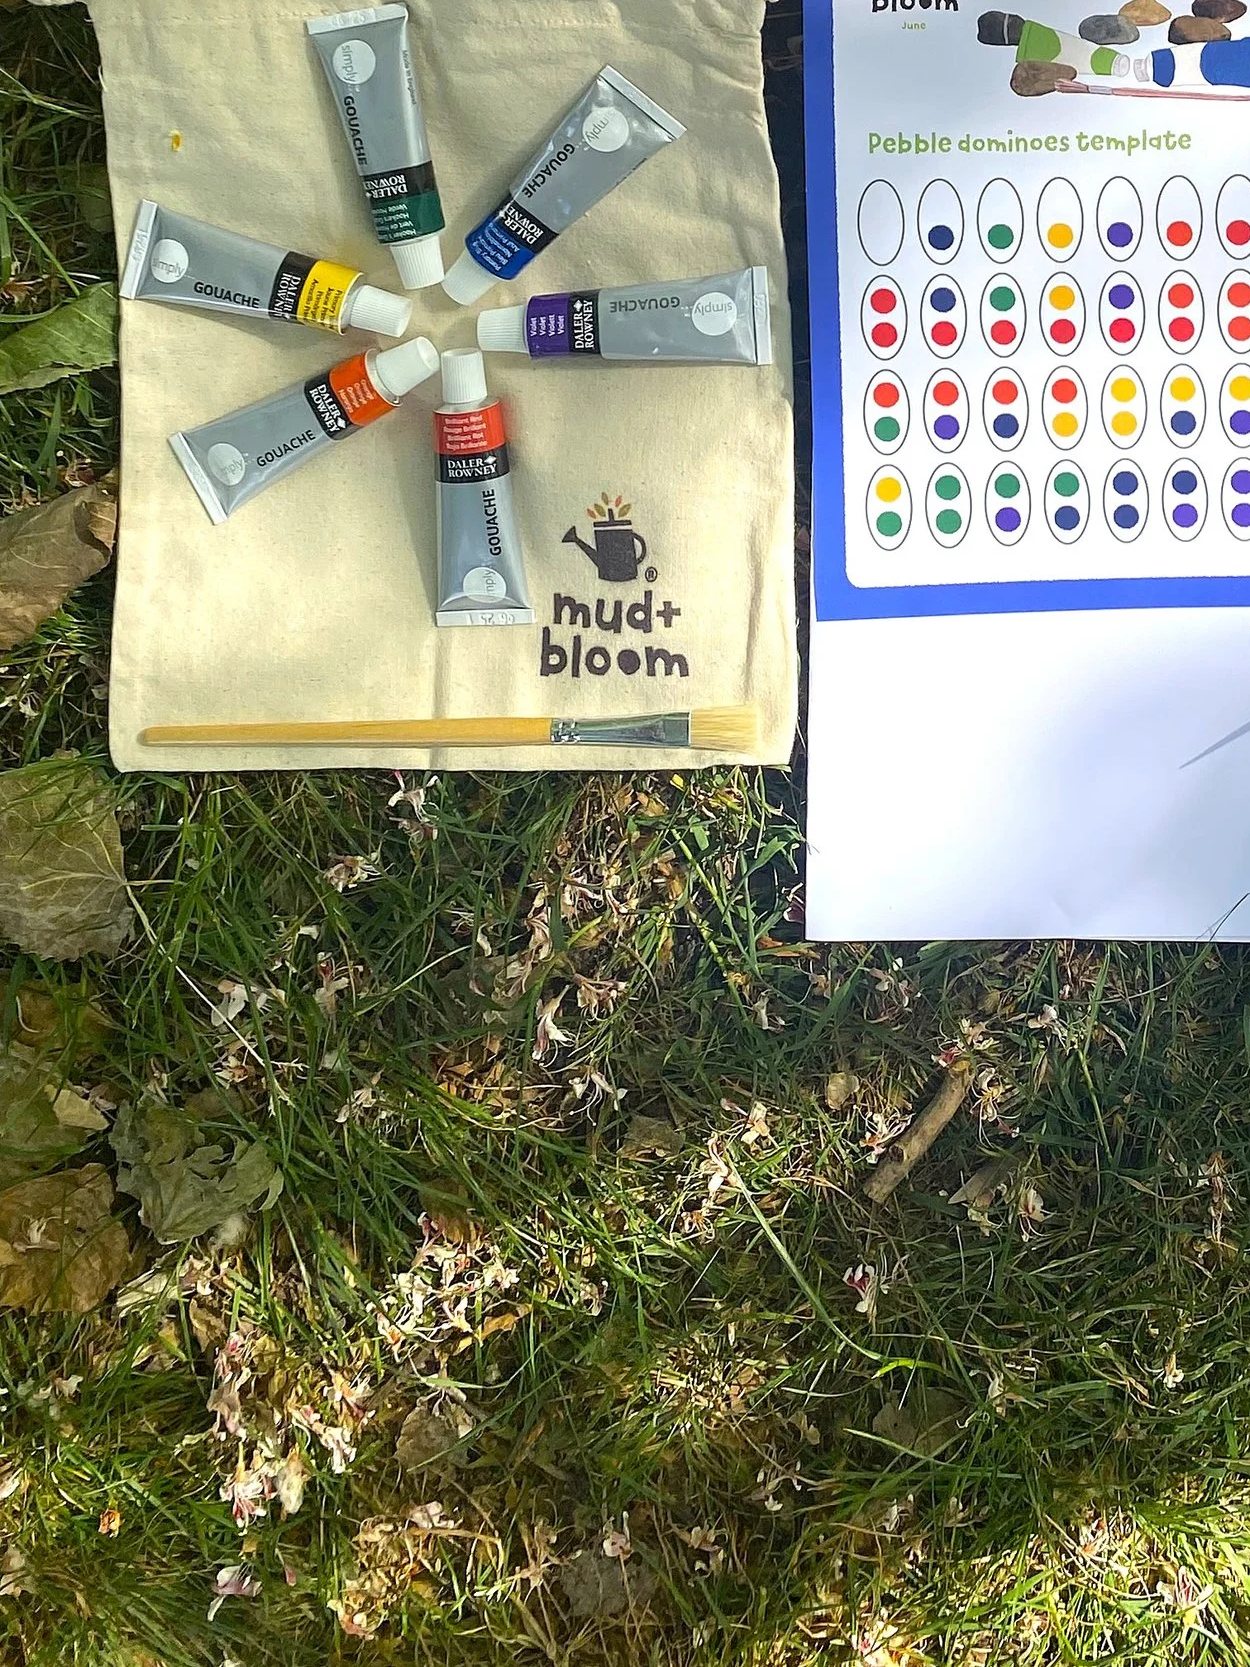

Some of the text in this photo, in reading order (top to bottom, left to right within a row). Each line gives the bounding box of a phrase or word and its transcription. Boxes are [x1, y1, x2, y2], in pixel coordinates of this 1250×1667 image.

[902, 20, 926, 30] June
[344, 96, 367, 166] GOUACHE
[868, 128, 1191, 154] Pebble dominoes template
[522, 143, 575, 199] GOUACHE
[372, 184, 407, 199] DALER
[504, 214, 537, 245] DALER
[194, 281, 260, 308] GOUACHE
[610, 296, 680, 313] GOUACHE
[694, 303, 733, 314] simply
[575, 311, 584, 348] DALER
[585, 300, 594, 349] ROWNEY
[309, 389, 340, 432] ROWNEY
[318, 384, 338, 418] DALER
[257, 430, 316, 467] GOUACHE
[448, 459, 484, 469] DALER
[449, 464, 497, 477] ROWNEY
[483, 489, 501, 556] GOUACHE
[554, 590, 681, 633] mud+
[540, 626, 689, 678] bloom
